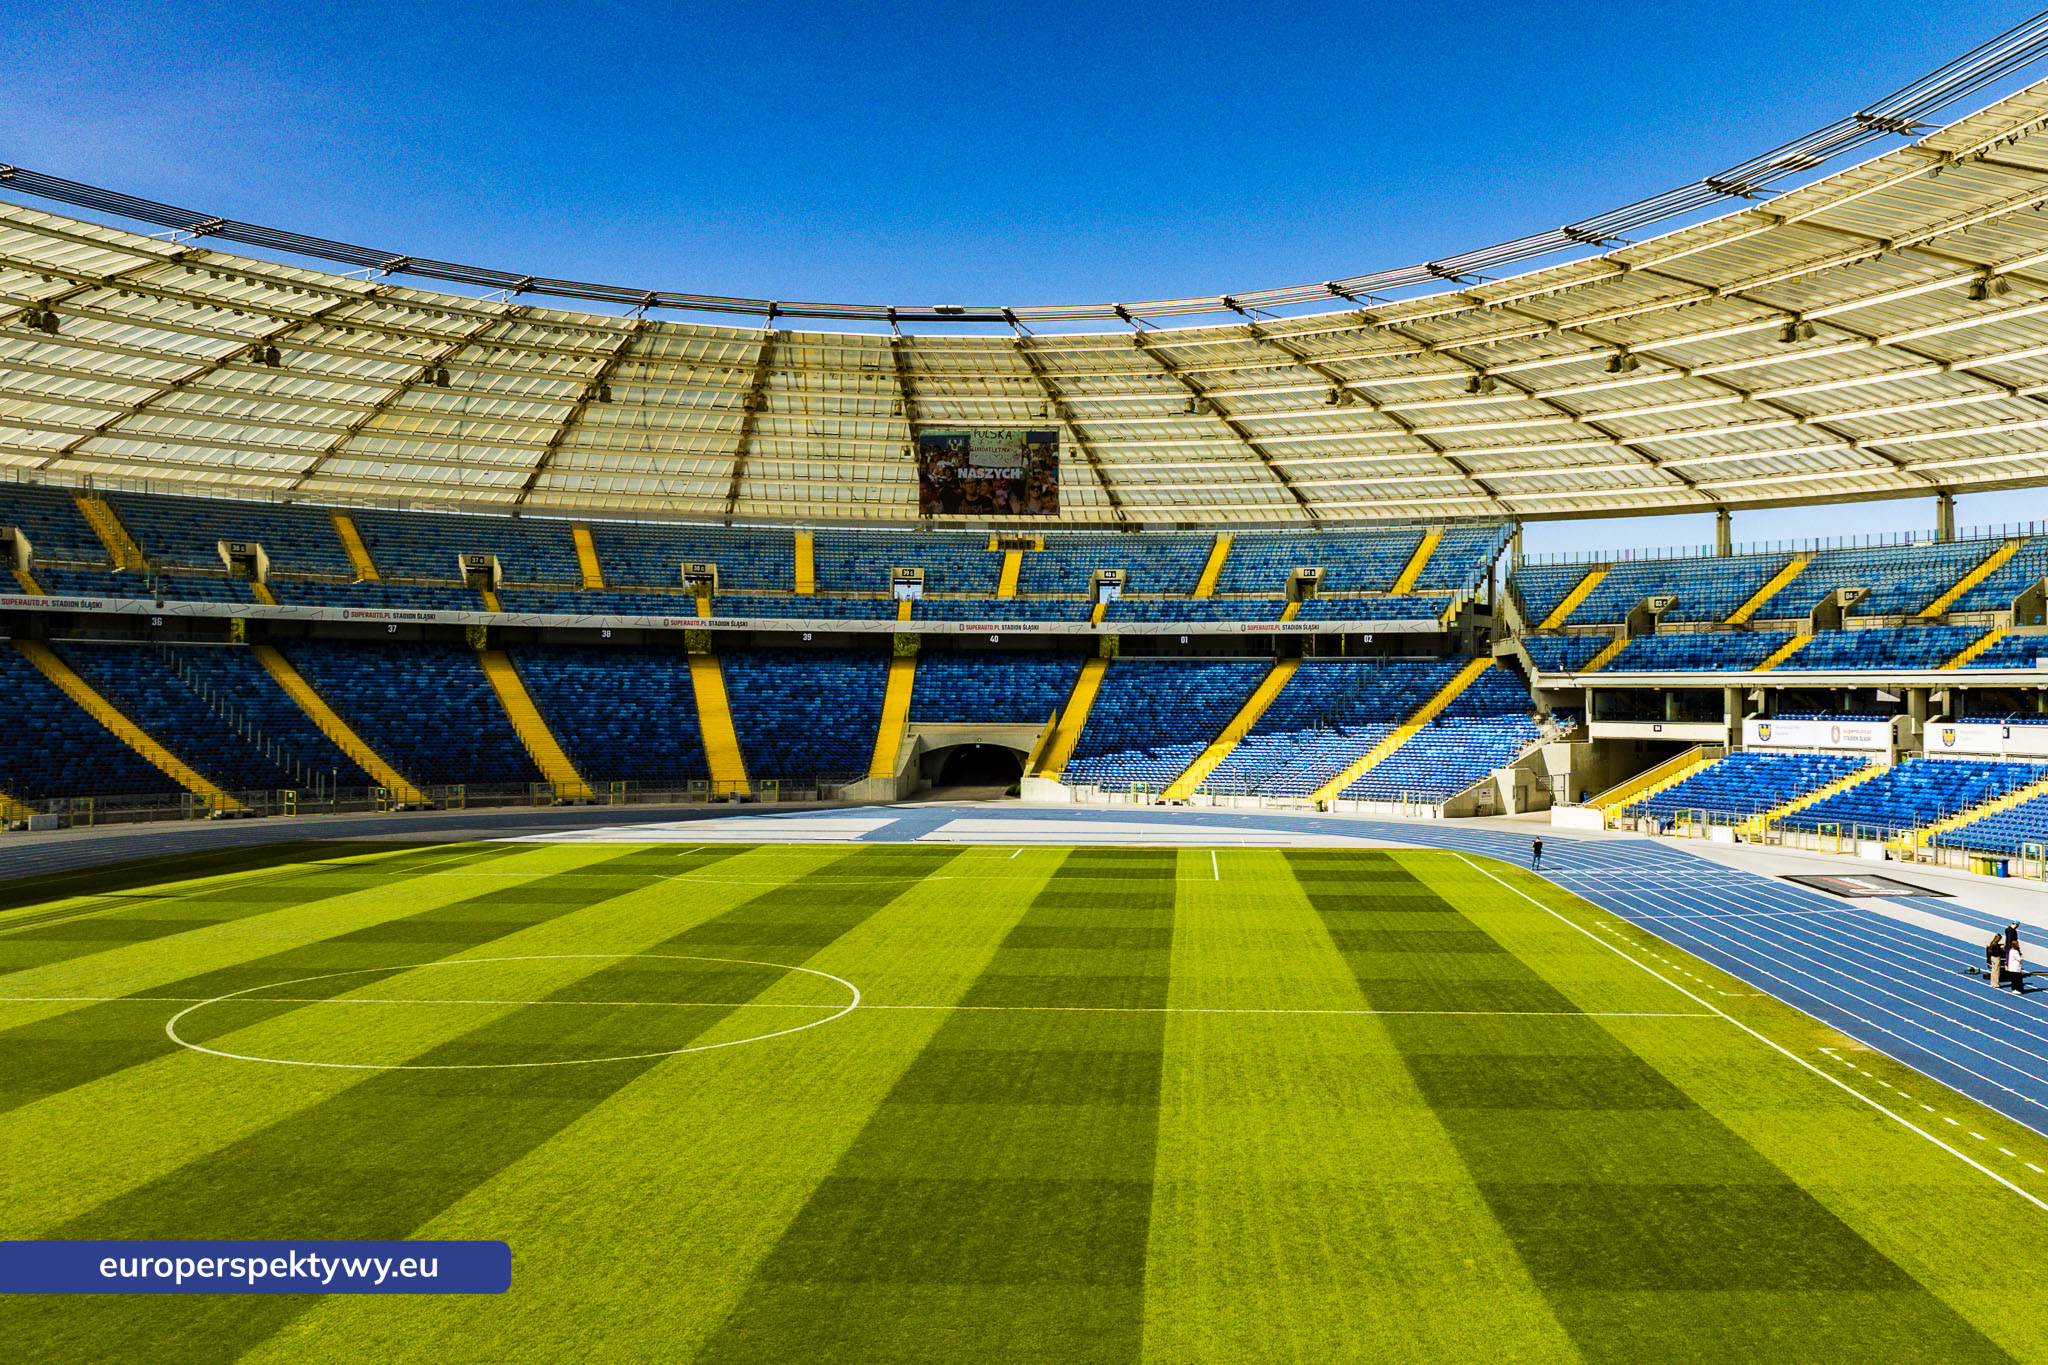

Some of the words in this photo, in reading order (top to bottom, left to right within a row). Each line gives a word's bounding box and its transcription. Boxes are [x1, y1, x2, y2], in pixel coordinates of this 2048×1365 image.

[957, 468, 1020, 479] NASZYCH
[1, 599, 49, 608] SUPERAUTO.PL
[52, 600, 79, 608] STADION
[80, 599, 102, 610] ŚLĄSKI
[350, 611, 391, 619] SUPERAUTO.PL
[417, 612, 436, 621] ŚLĄSKI
[151, 617, 163, 626] 36
[730, 620, 748, 629] ŚLĄSKI
[387, 624, 397, 633] 37
[1022, 623, 1039, 632] ŚLĄSKI
[1303, 623, 1320, 632] ŚLĄSKI
[802, 633, 812, 641] 39
[990, 635, 999, 643] 40
[1181, 636, 1188, 644] 01
[1364, 635, 1373, 643] 02
